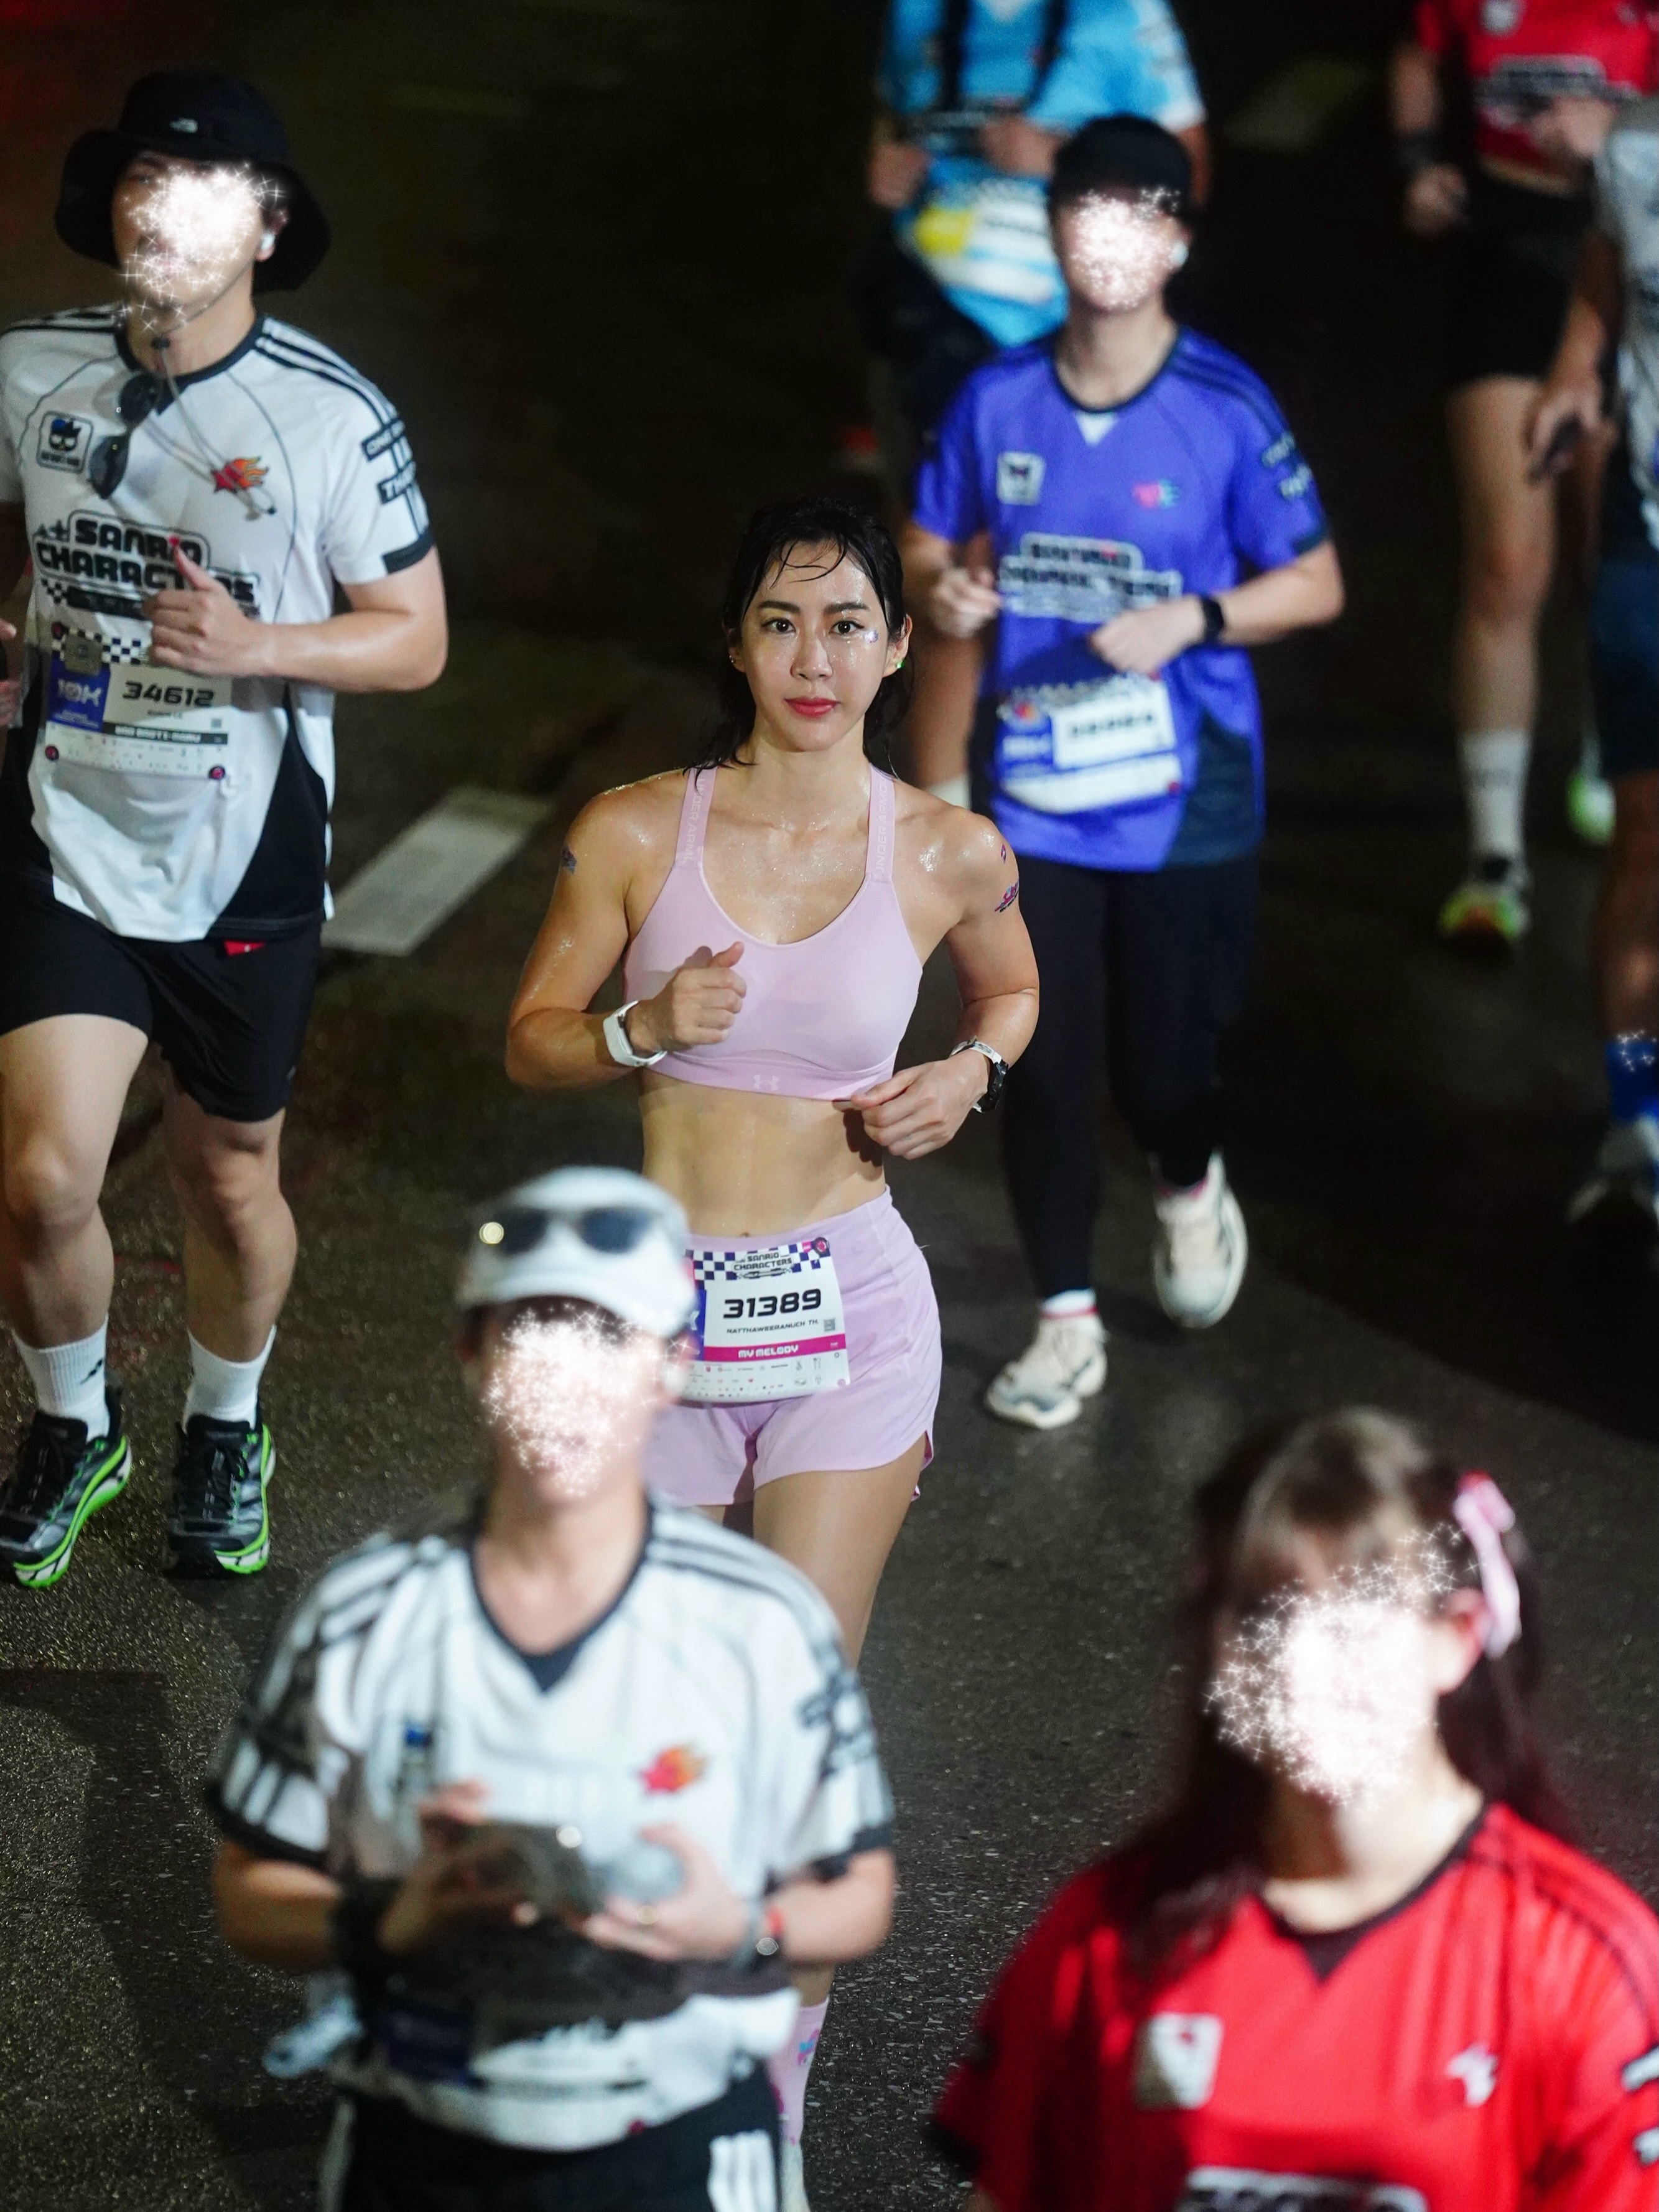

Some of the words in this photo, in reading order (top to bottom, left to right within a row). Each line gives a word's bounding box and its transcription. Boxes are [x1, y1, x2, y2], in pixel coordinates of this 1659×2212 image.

[37, 541, 254, 603] CHARACTS
[123, 681, 214, 707] 34612
[734, 1258, 792, 1271] CHARACTERS
[723, 1288, 821, 1319] 31389
[738, 1349, 754, 1359] MY
[756, 1344, 799, 1357] MELODY
